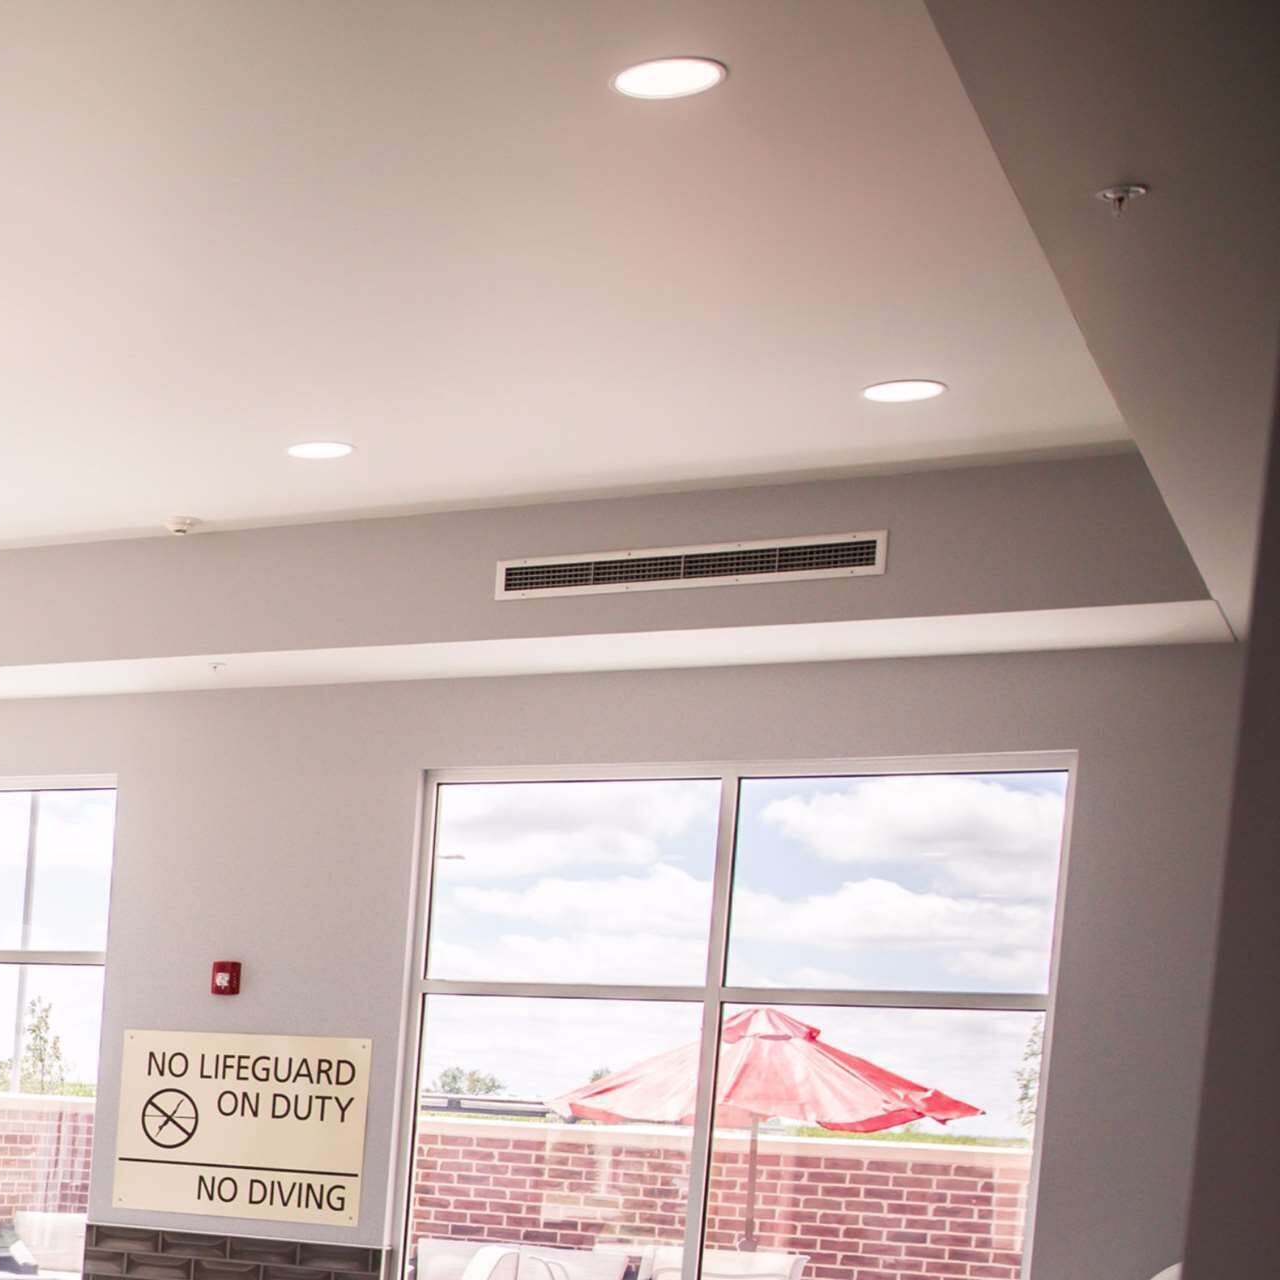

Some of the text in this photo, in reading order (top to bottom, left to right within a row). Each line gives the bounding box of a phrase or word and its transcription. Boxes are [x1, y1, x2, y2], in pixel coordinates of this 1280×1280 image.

[147, 1051, 356, 1086] NO LIFEGUARD
[217, 1090, 355, 1123] ON DUTY
[197, 1175, 346, 1211] NO DIVING
